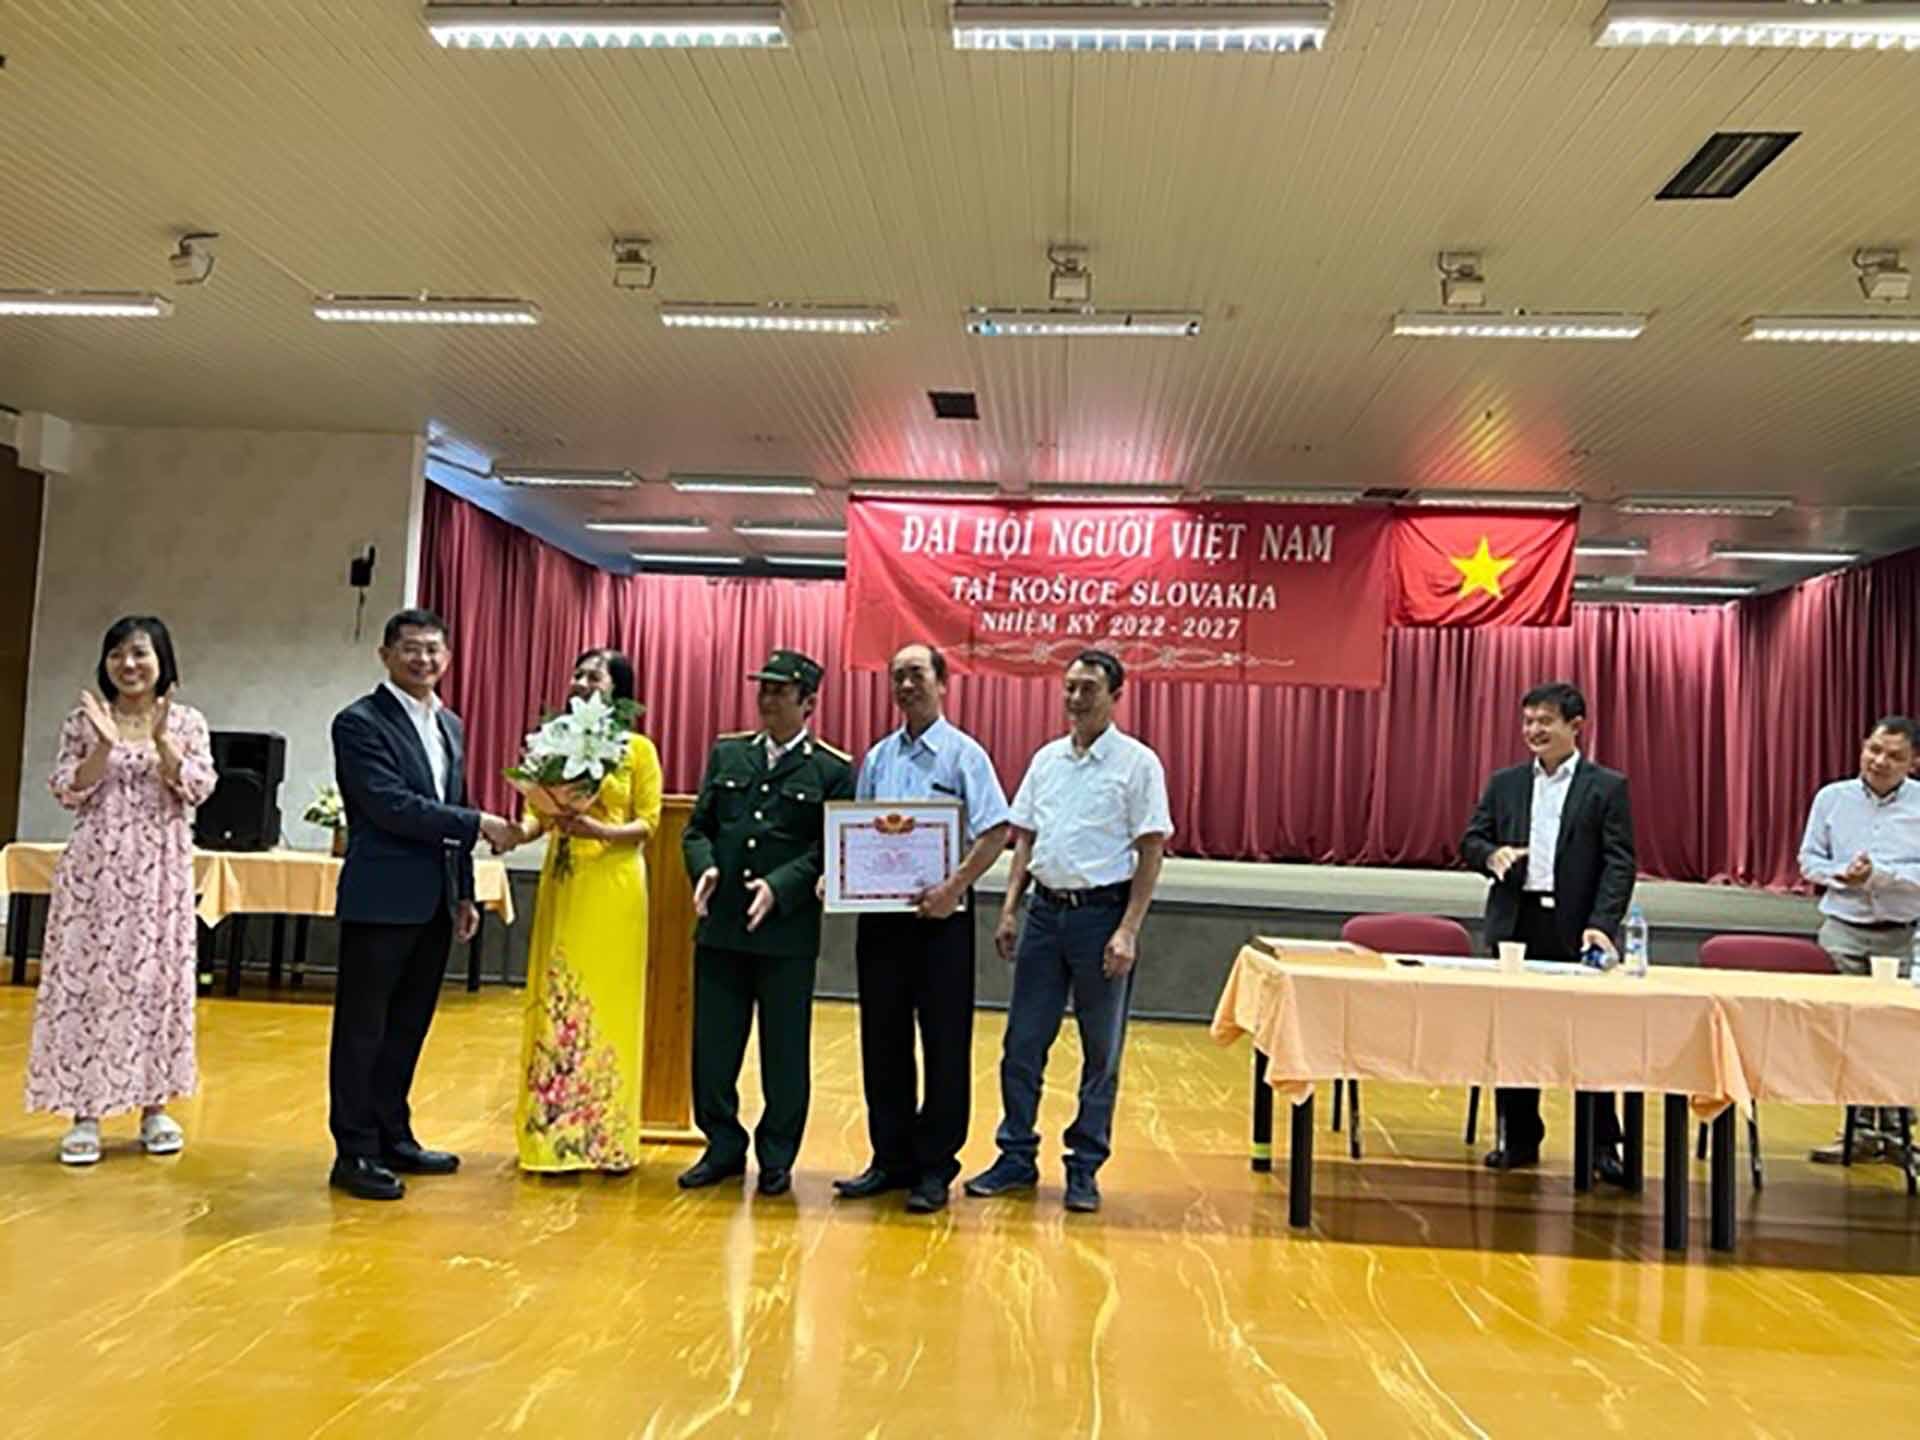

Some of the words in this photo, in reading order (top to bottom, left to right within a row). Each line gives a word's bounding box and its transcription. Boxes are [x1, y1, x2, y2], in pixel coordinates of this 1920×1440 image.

[1259, 523, 1336, 564] NAM
[1009, 572, 1121, 607] KOŠICE
[1129, 579, 1278, 610] SLOVAKIA
